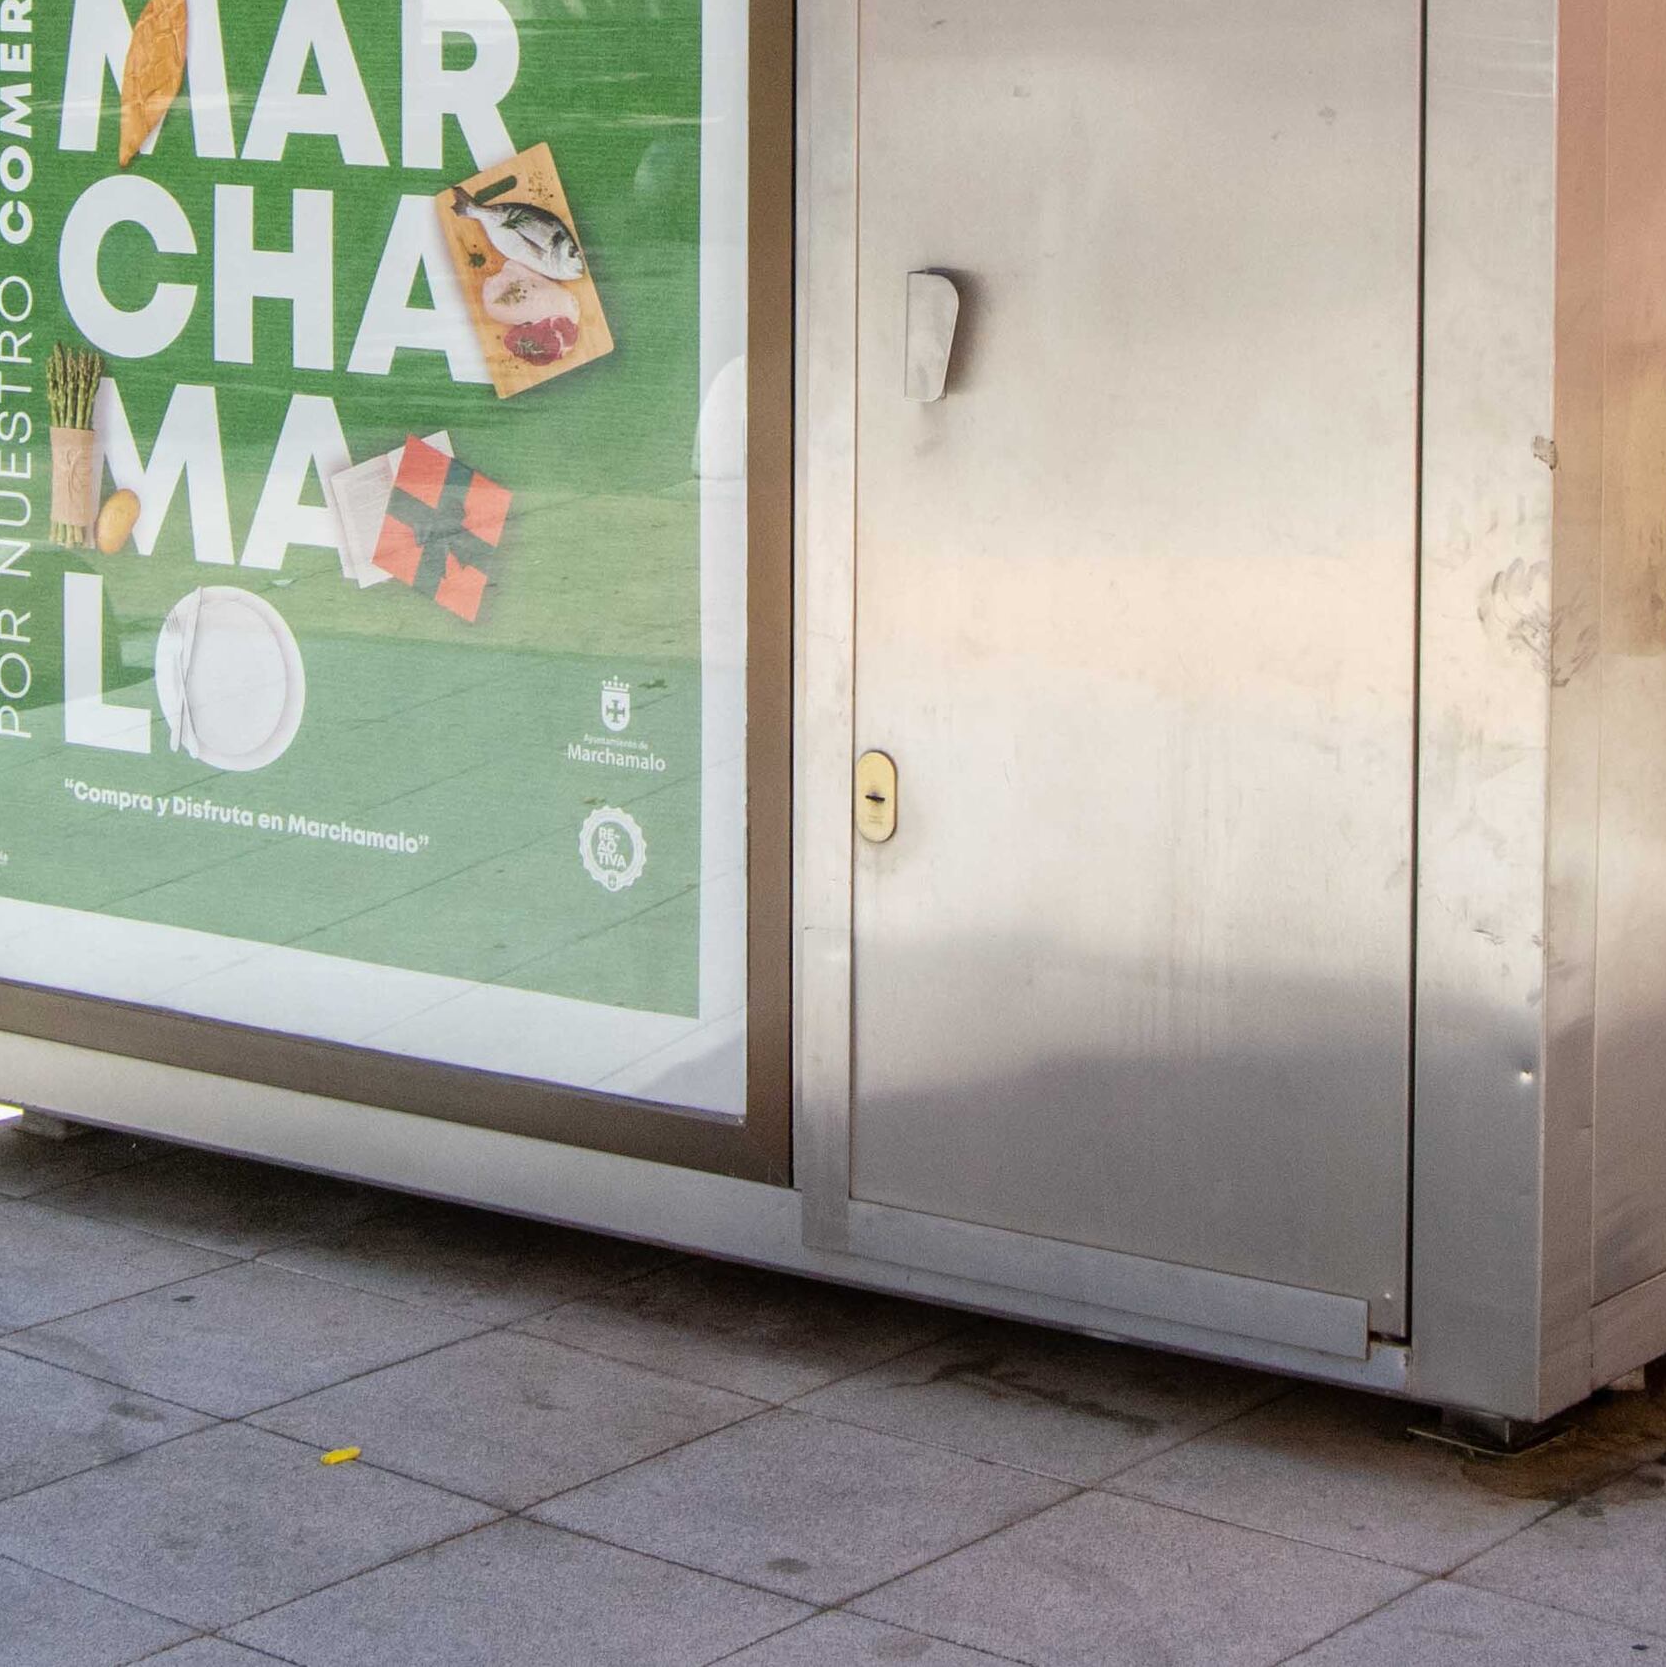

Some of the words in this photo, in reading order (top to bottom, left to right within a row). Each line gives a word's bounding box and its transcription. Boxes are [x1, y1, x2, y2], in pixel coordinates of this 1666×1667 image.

[59, 175, 495, 384] CHA
[97, 377, 361, 571] MA
[64, 778, 153, 812] “Compra
[156, 797, 170, 817] y
[173, 796, 254, 828] Disfruta
[258, 811, 283, 832] en
[287, 814, 430, 853] Marchamalo”
[568, 743, 666, 772] Marchamalo
